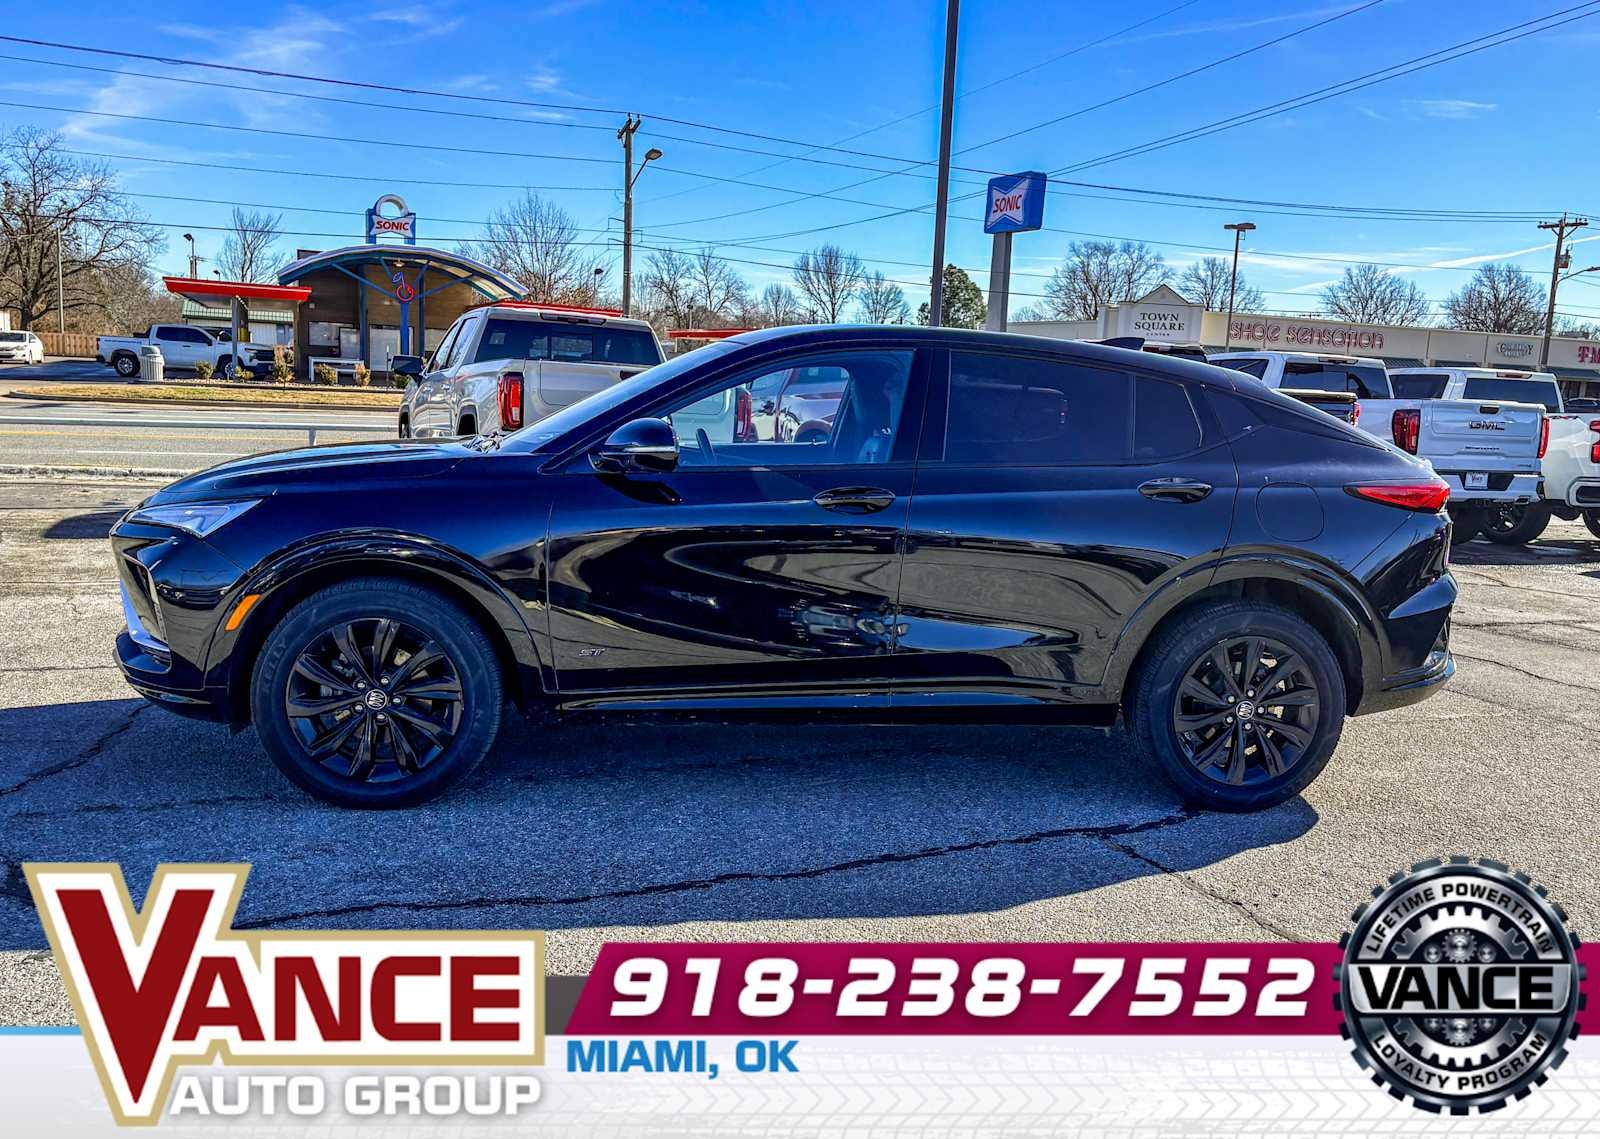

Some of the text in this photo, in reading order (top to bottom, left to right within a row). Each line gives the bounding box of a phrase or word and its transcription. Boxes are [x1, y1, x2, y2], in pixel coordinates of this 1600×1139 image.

[992, 194, 1022, 214] SONIC
[375, 221, 410, 231] SONIC
[1140, 312, 1180, 322] TOWN
[1134, 321, 1185, 332] SQUARE
